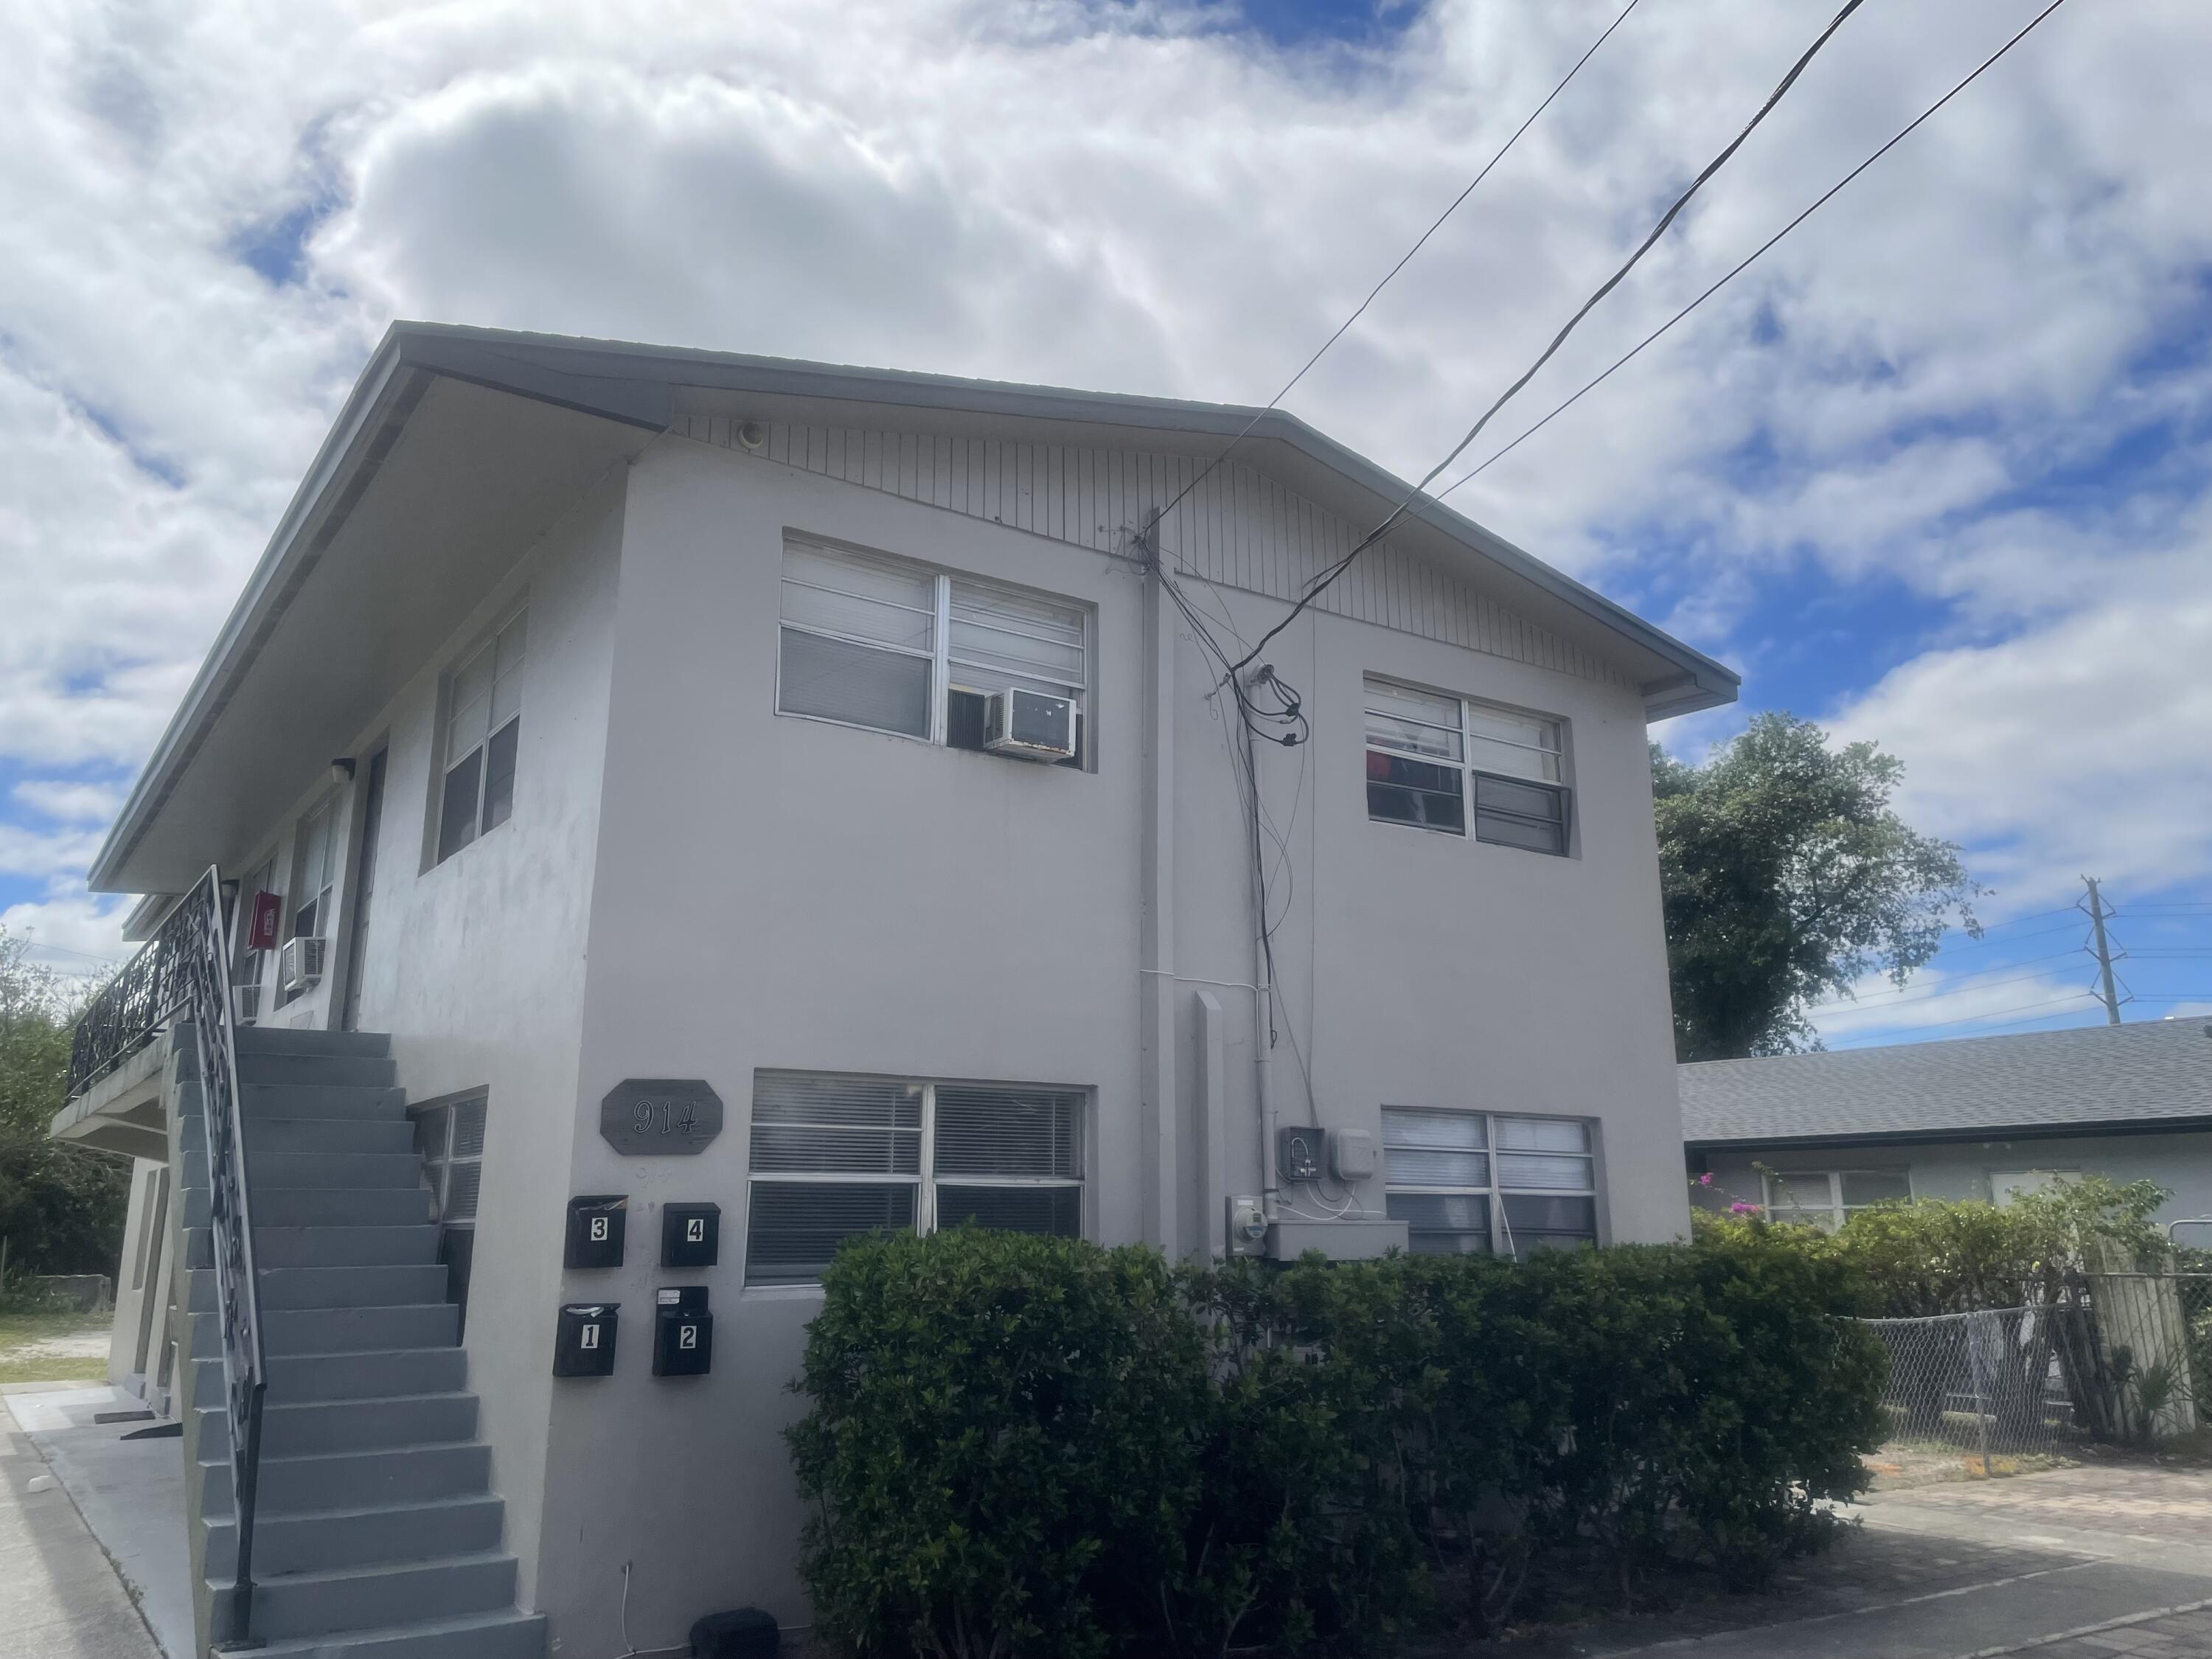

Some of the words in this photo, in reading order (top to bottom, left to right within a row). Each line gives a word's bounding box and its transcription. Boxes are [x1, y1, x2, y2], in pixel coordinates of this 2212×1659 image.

[634, 1100, 697, 1133] 914
[594, 1219, 605, 1239] 3
[689, 1221, 701, 1240] 4
[585, 1326, 594, 1347] 1
[683, 1328, 694, 1347] 2
